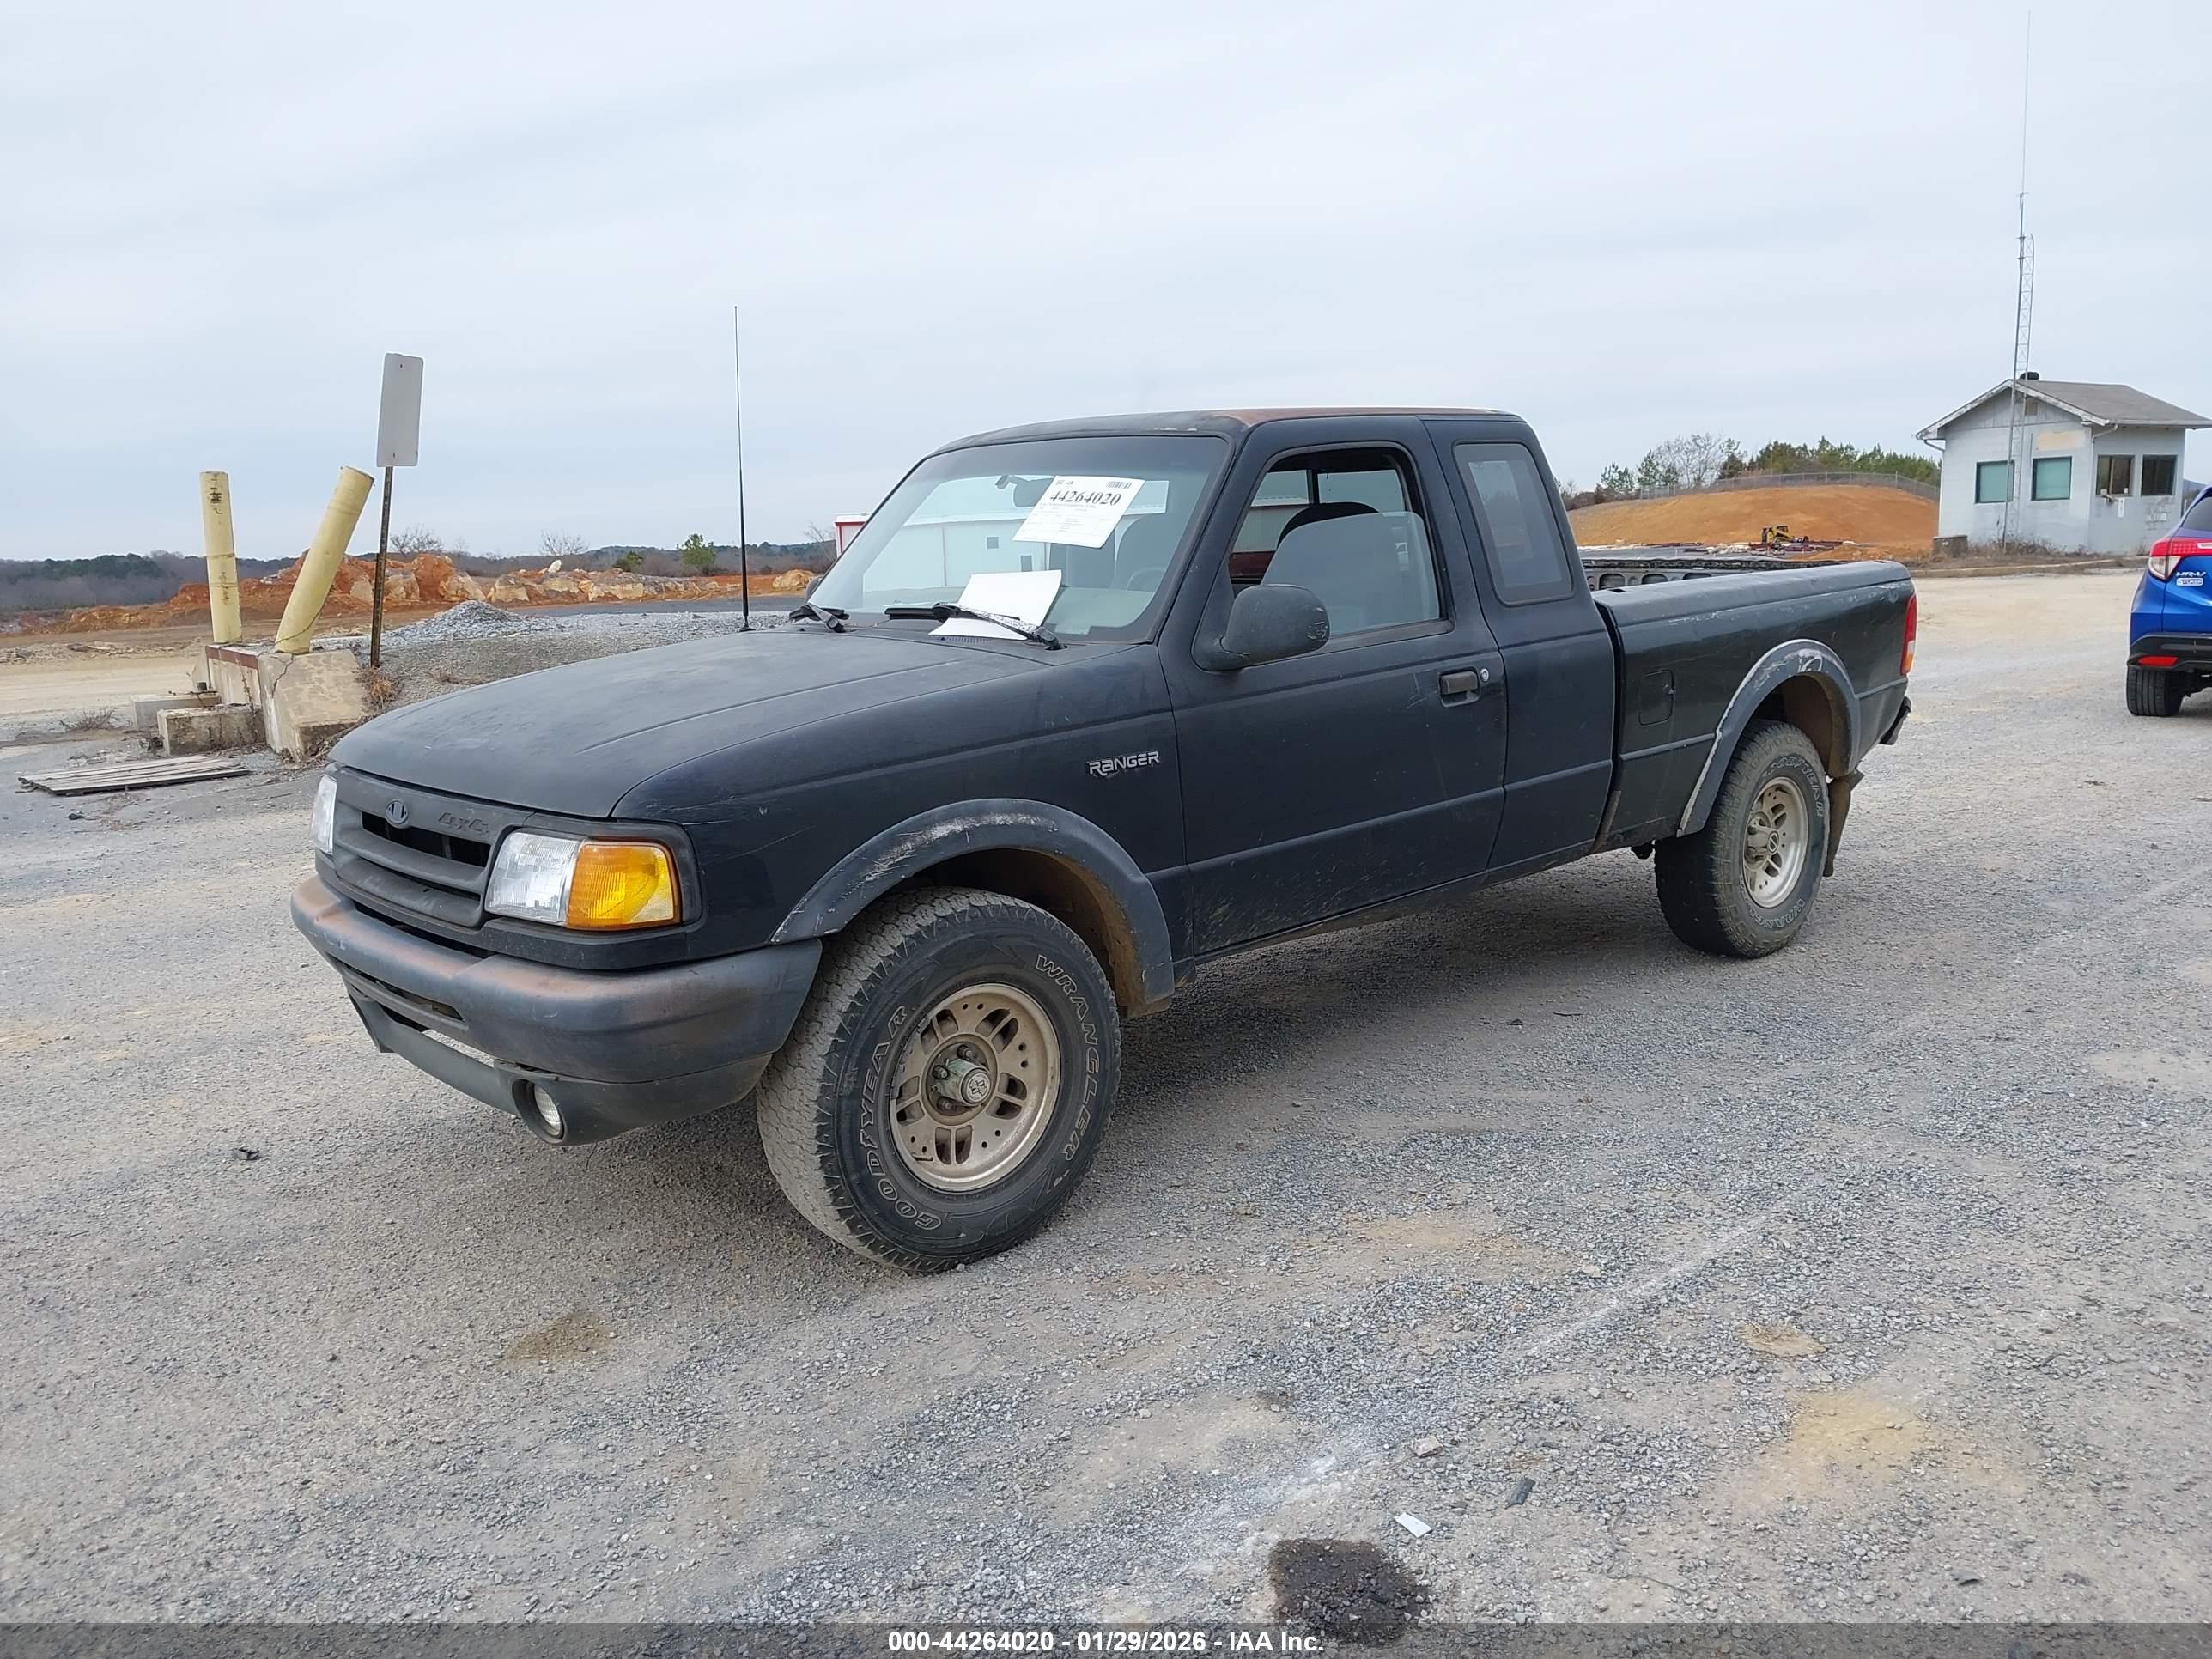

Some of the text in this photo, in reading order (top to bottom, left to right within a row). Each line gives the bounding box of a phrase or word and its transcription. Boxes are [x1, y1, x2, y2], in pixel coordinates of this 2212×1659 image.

[1050, 489, 1121, 506] 44264020
[1089, 750, 1159, 776] RANGER
[1035, 954, 1101, 1162] WRANGLER
[860, 1005, 943, 1231] GOODYEAR
